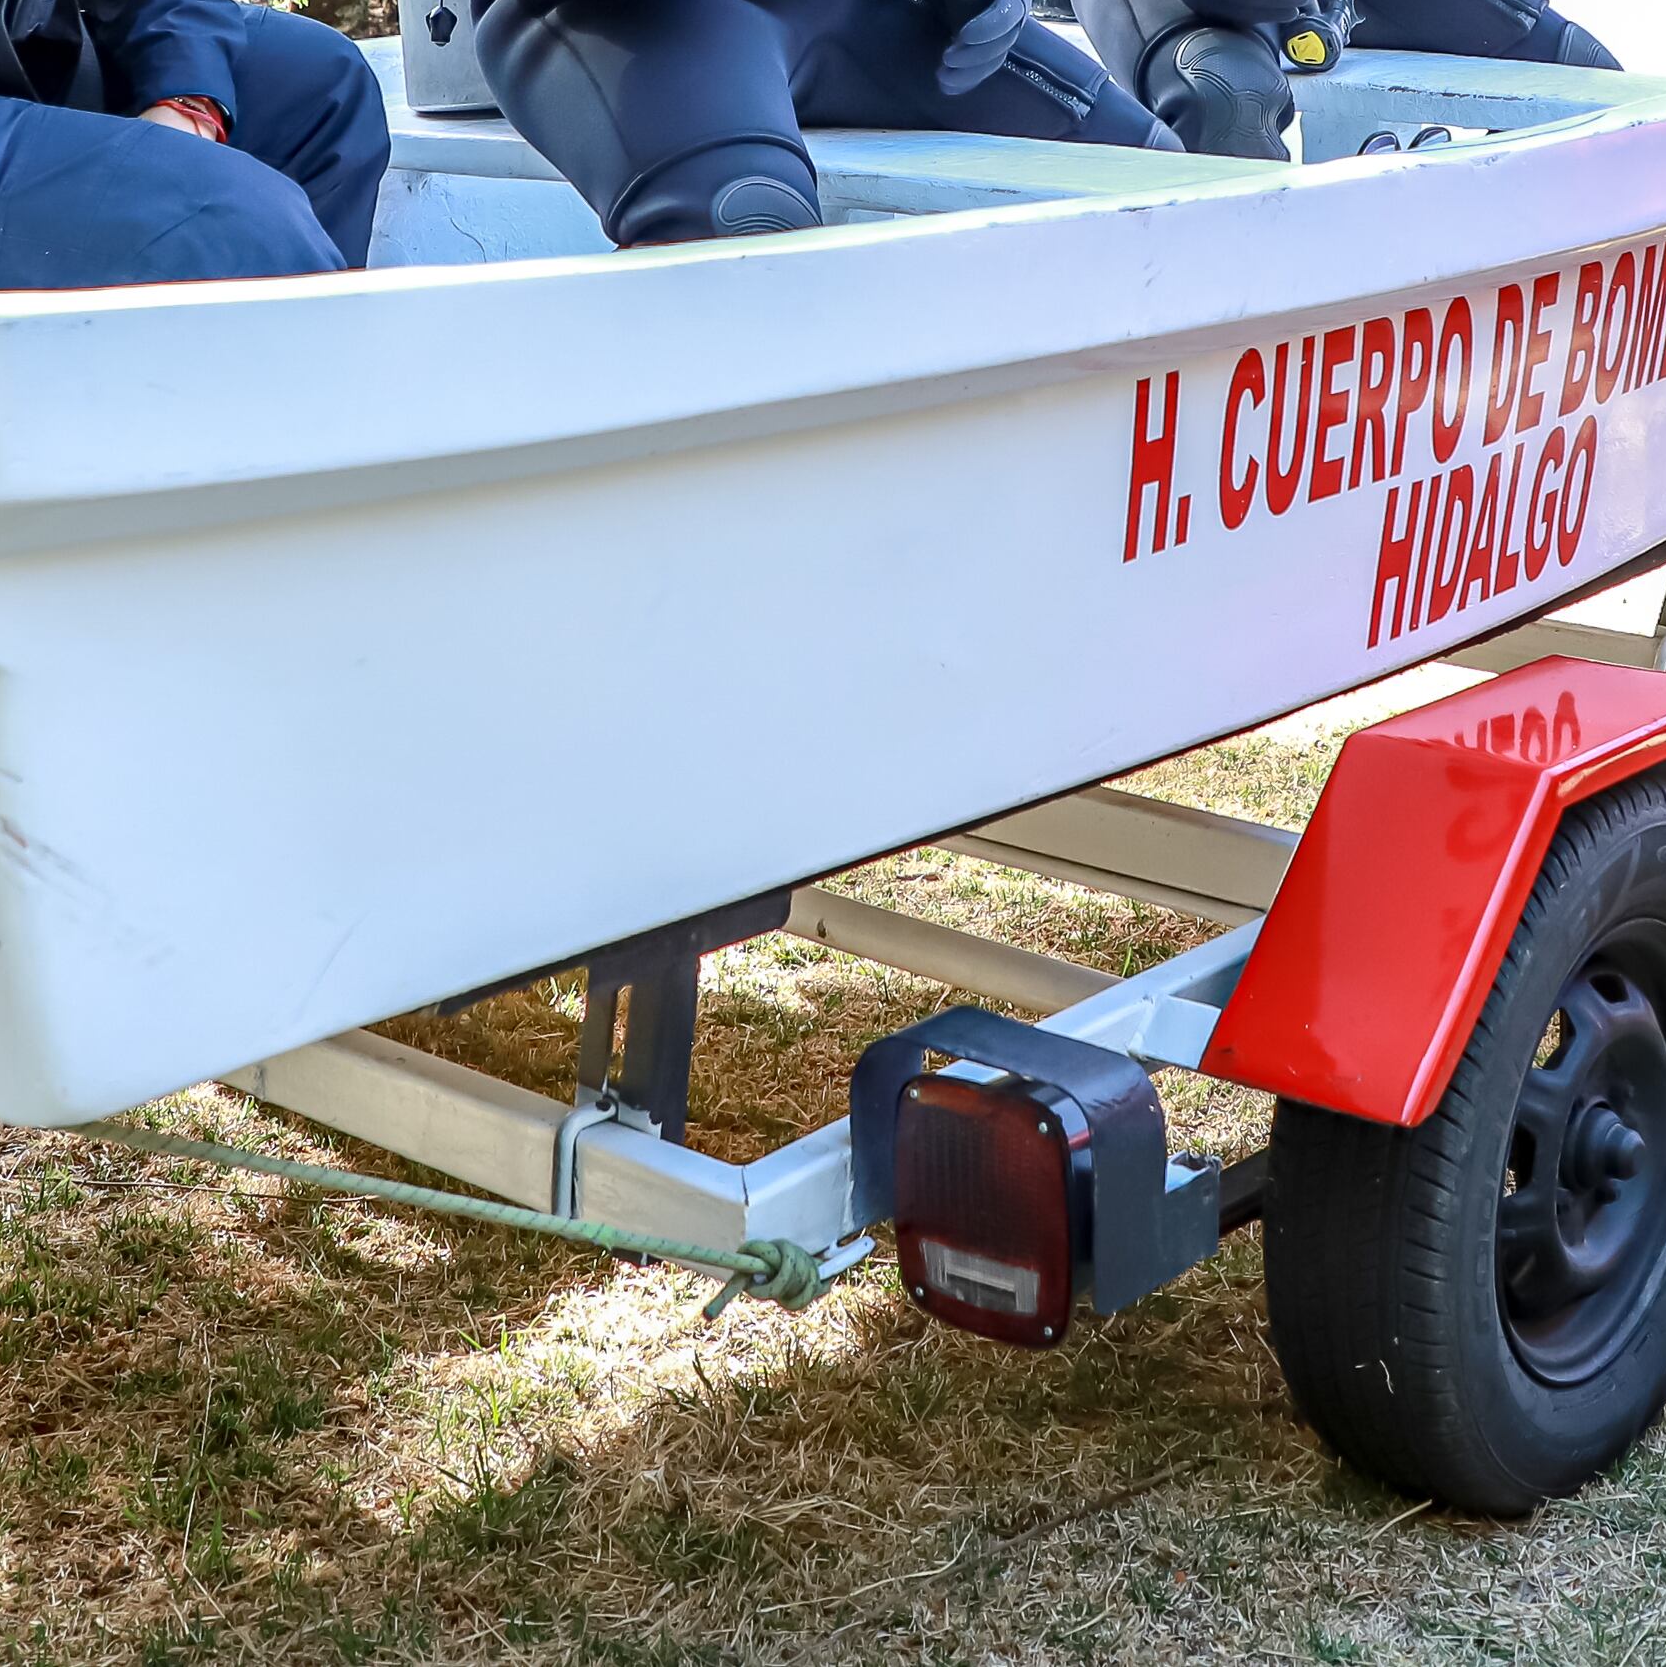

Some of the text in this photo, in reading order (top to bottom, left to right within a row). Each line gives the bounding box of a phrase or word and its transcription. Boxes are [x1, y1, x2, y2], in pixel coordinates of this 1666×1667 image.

[1123, 369, 1192, 563] H.
[1219, 295, 1472, 531] CUERPO
[1483, 271, 1561, 448] DE
[1366, 414, 1597, 651] HIDALGO
